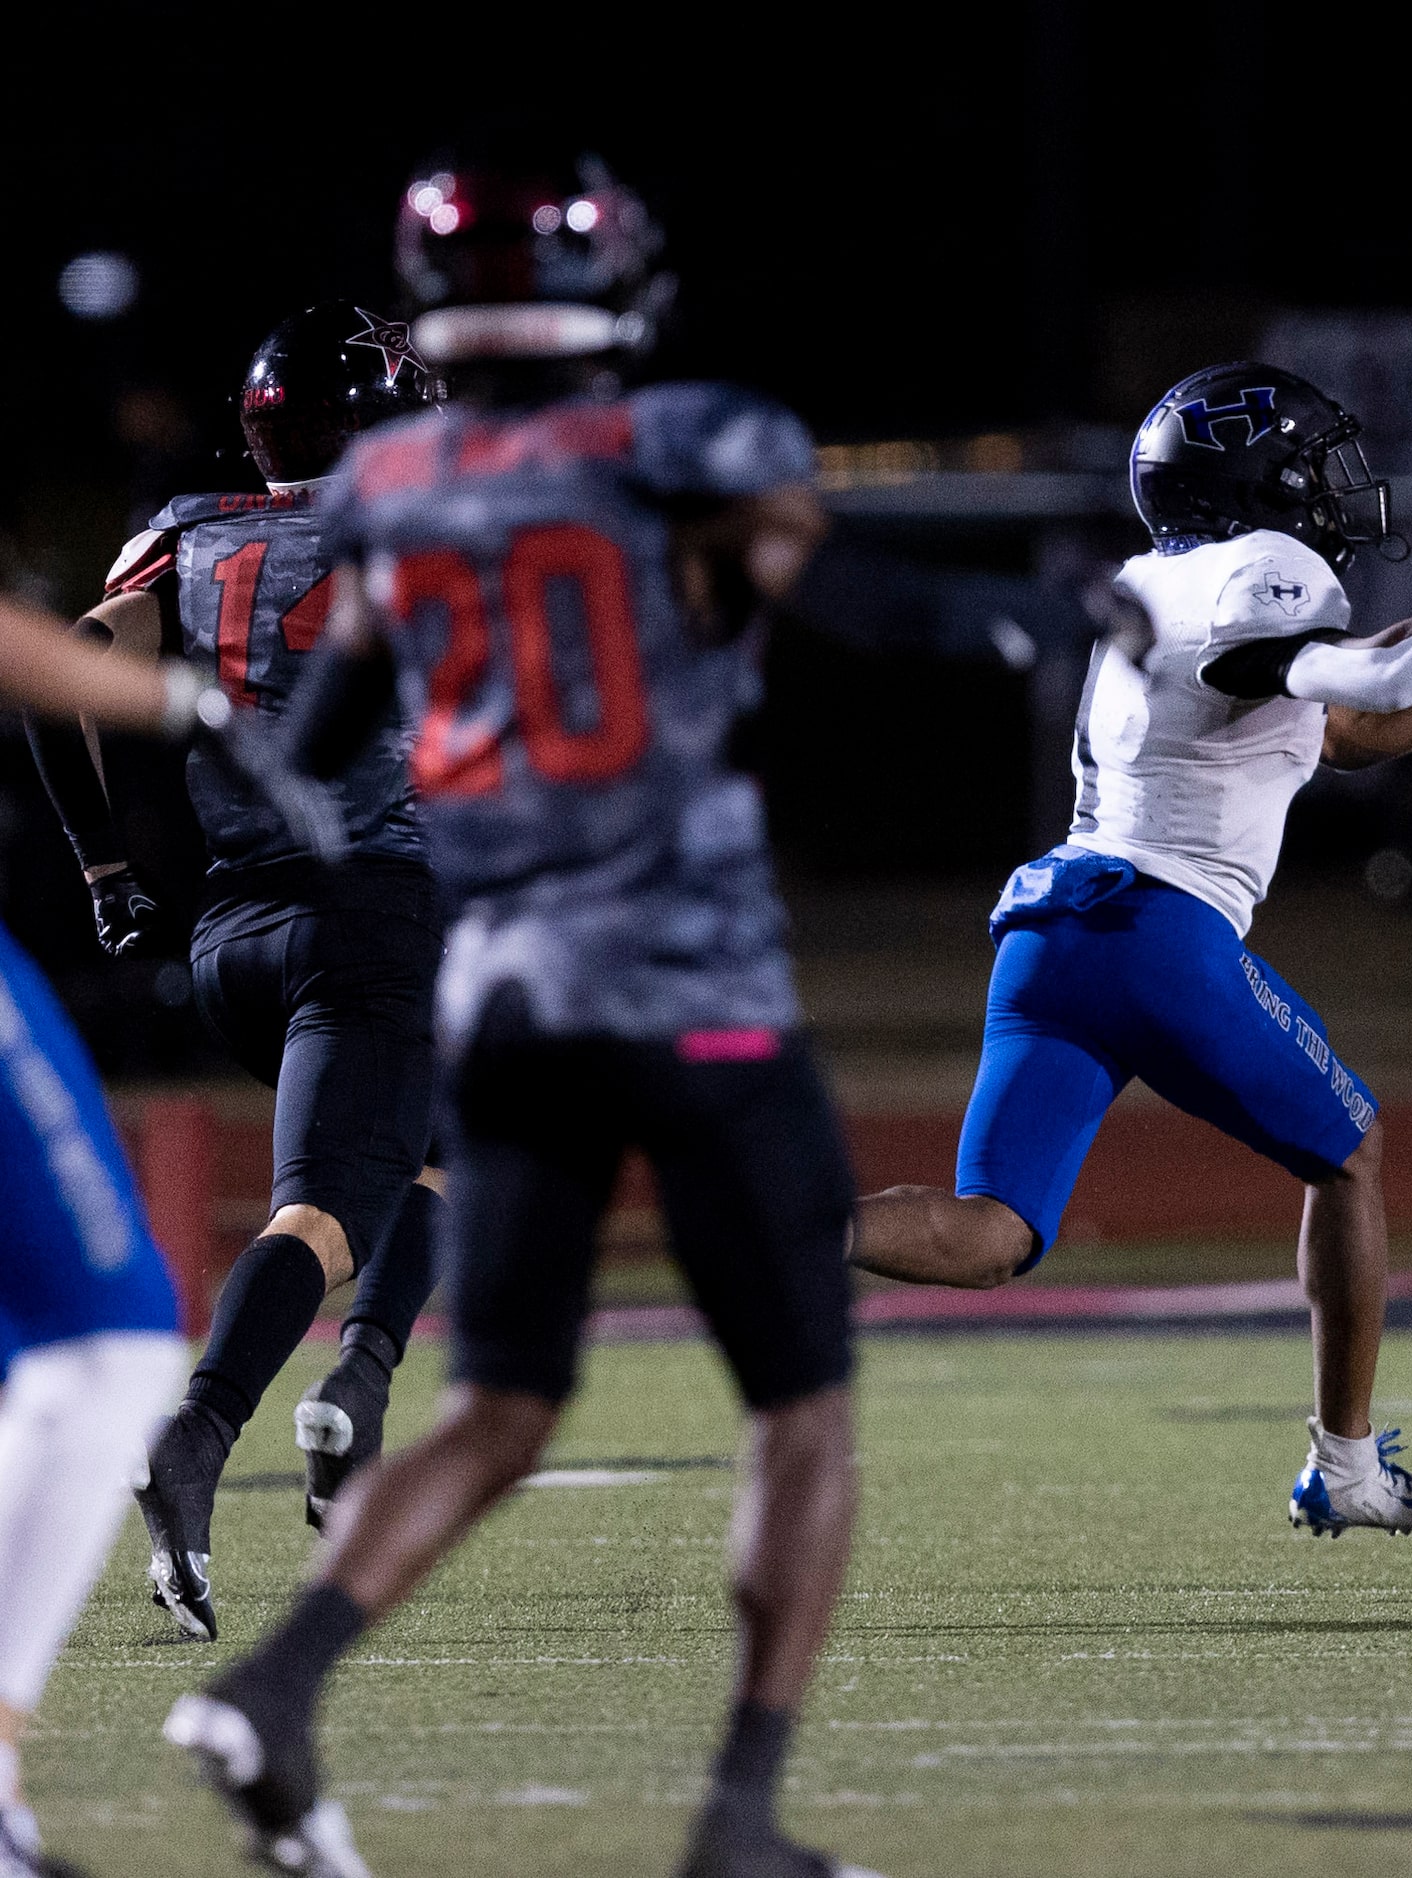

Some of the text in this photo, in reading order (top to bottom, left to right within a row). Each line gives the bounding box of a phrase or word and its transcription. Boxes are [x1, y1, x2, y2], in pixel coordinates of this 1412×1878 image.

[1173, 386, 1277, 452] H
[1268, 585, 1304, 601] H
[392, 520, 650, 800] 20
[1239, 951, 1292, 1032] BRING
[1295, 1016, 1330, 1075] THE
